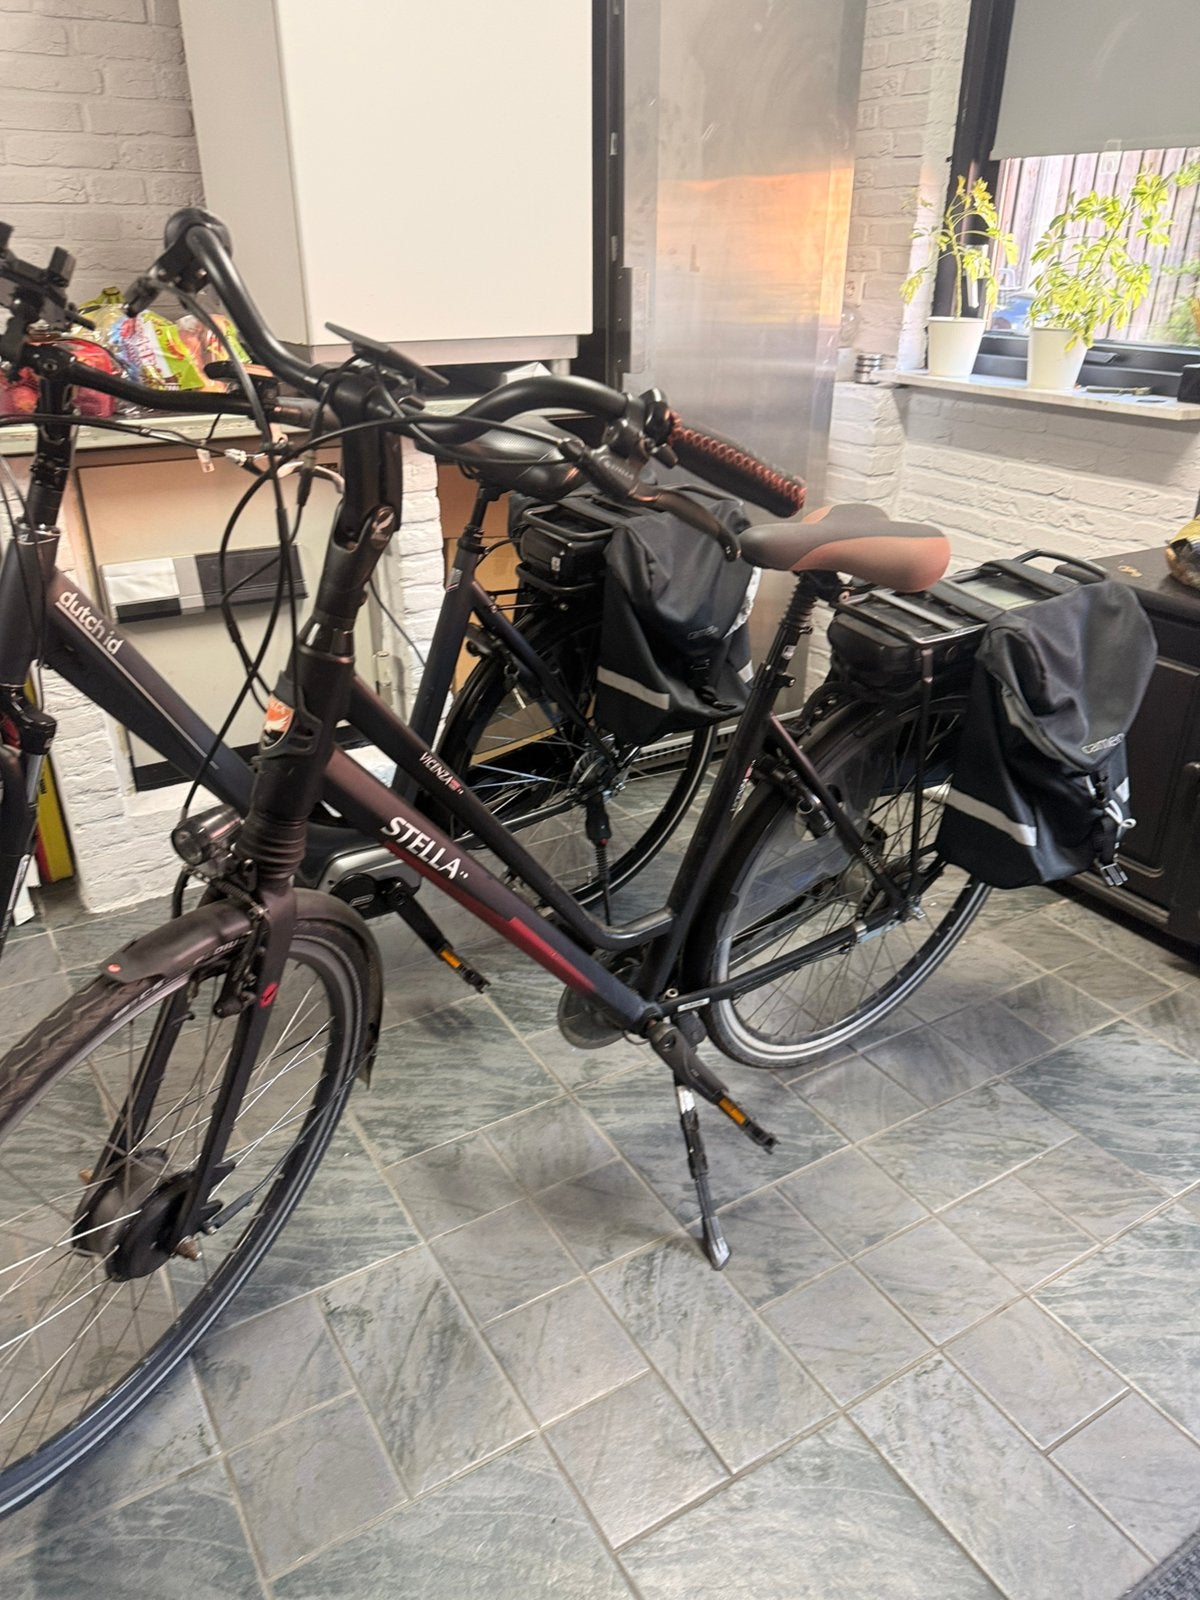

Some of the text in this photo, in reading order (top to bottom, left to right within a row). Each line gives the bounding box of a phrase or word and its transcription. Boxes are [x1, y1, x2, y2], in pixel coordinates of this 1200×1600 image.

[59, 591, 124, 655] dutch id
[420, 752, 453, 785] VICENZA
[380, 816, 461, 879] STELLA
